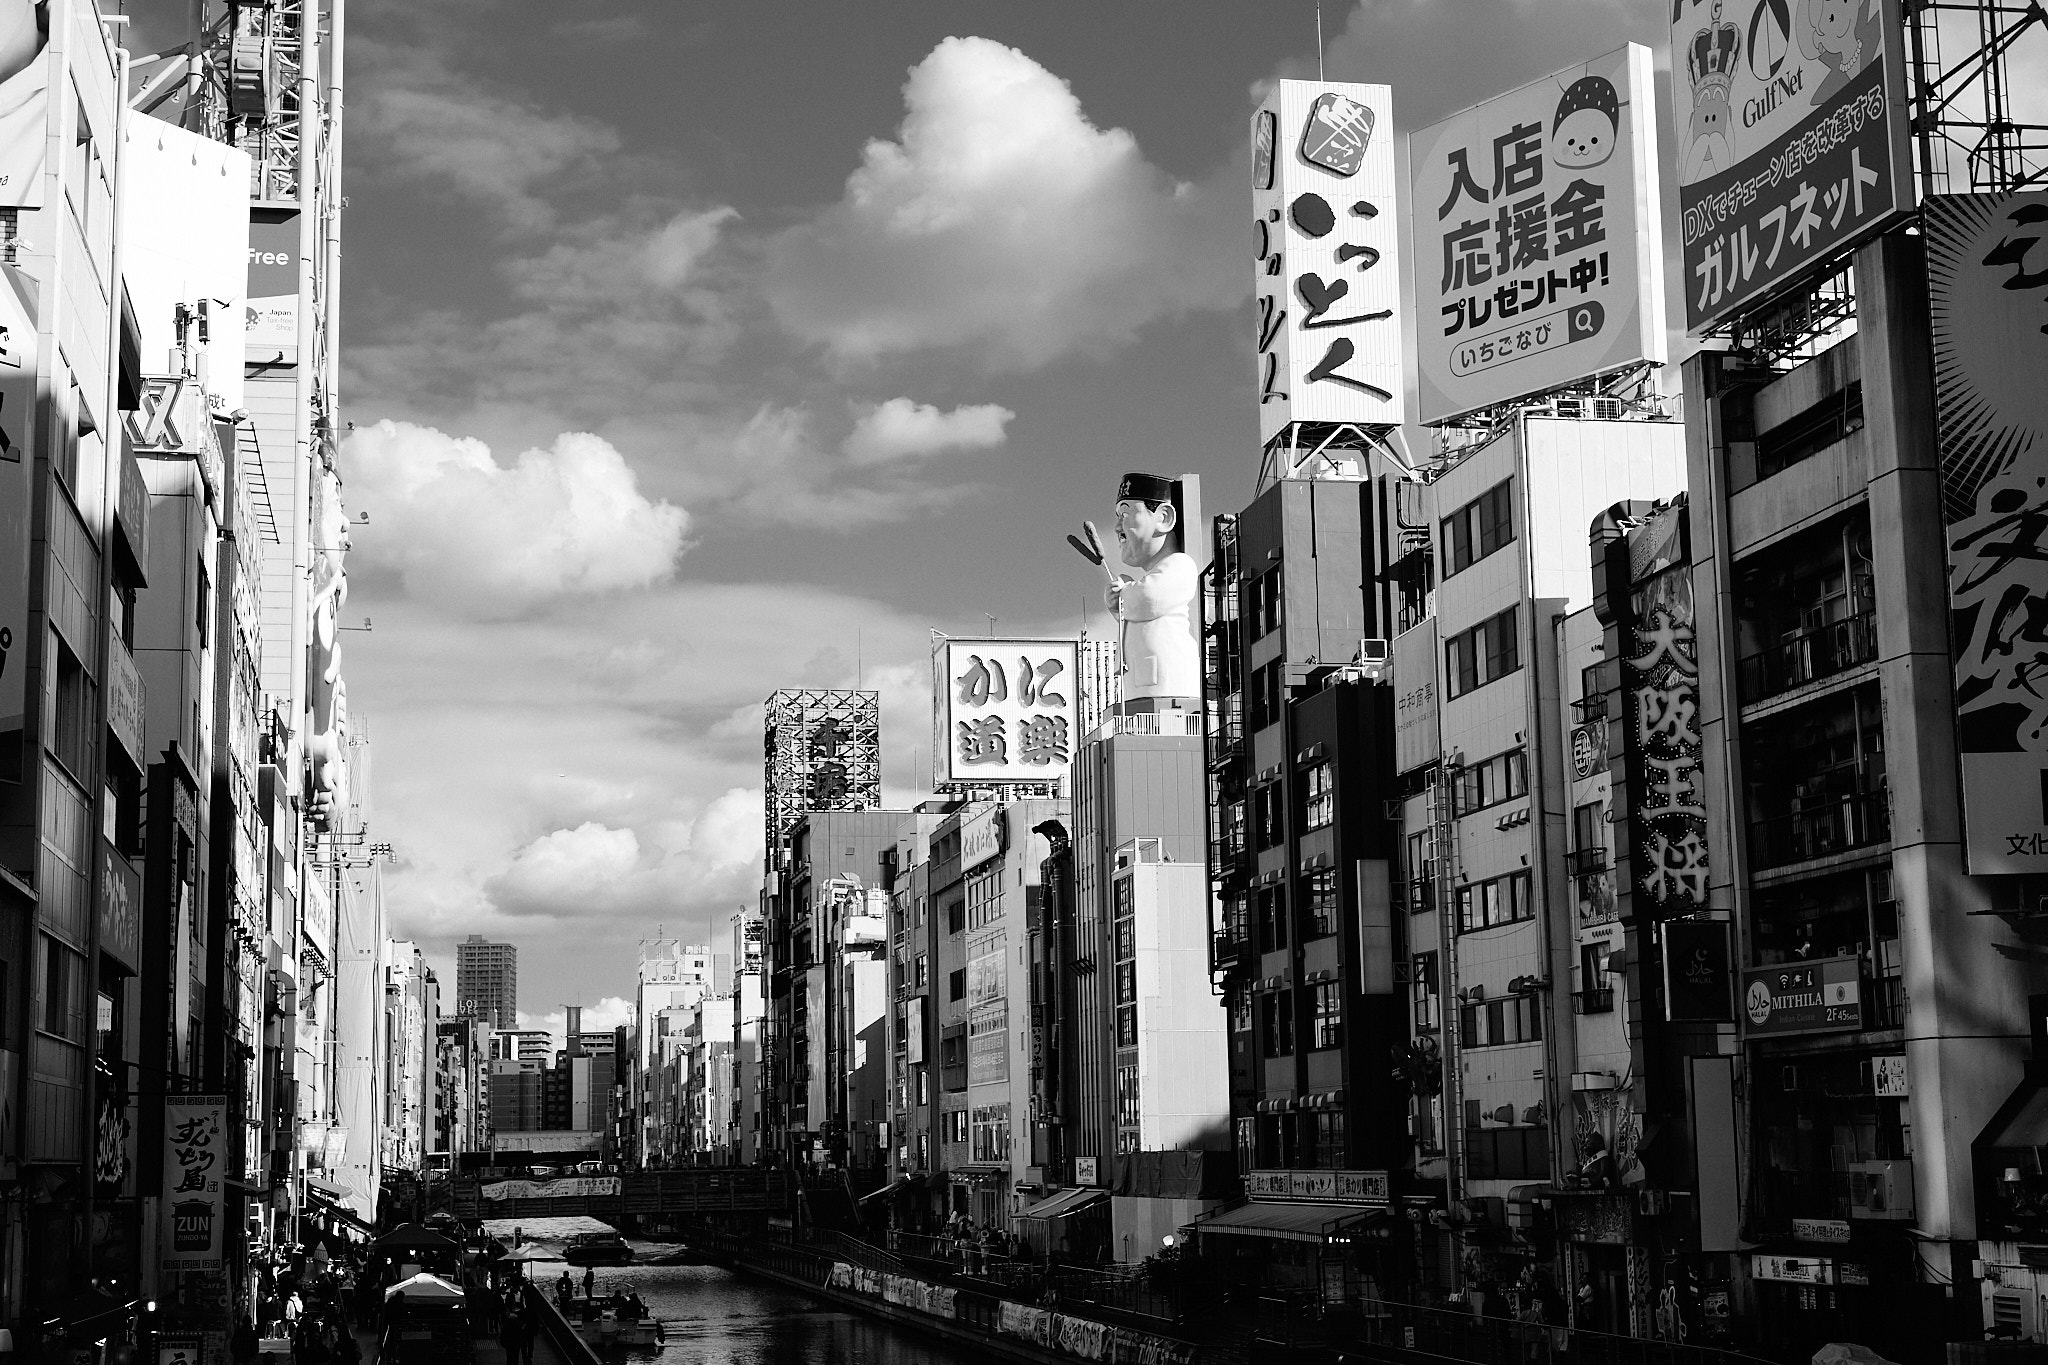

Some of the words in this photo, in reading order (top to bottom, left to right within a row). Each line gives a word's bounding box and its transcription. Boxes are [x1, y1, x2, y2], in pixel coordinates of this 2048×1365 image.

[1438, 120, 1544, 221] 入店
[1683, 84, 1886, 247] DXでチェーン店を改革する
[1440, 178, 1607, 297] 応援金
[1695, 146, 1879, 312] ガルフネット
[1441, 250, 1609, 337] プレゼント中!
[1459, 321, 1553, 368] いちごなび
[957, 655, 1067, 707] かに
[1624, 608, 1709, 904] 大阪王将
[1689, 976, 1713, 984] HALAL
[1771, 991, 1824, 1010] MITHILA
[1751, 1010, 1767, 1018] HALAL
[1826, 1007, 1838, 1022] 2F
[176, 1216, 210, 1232] ZUN
